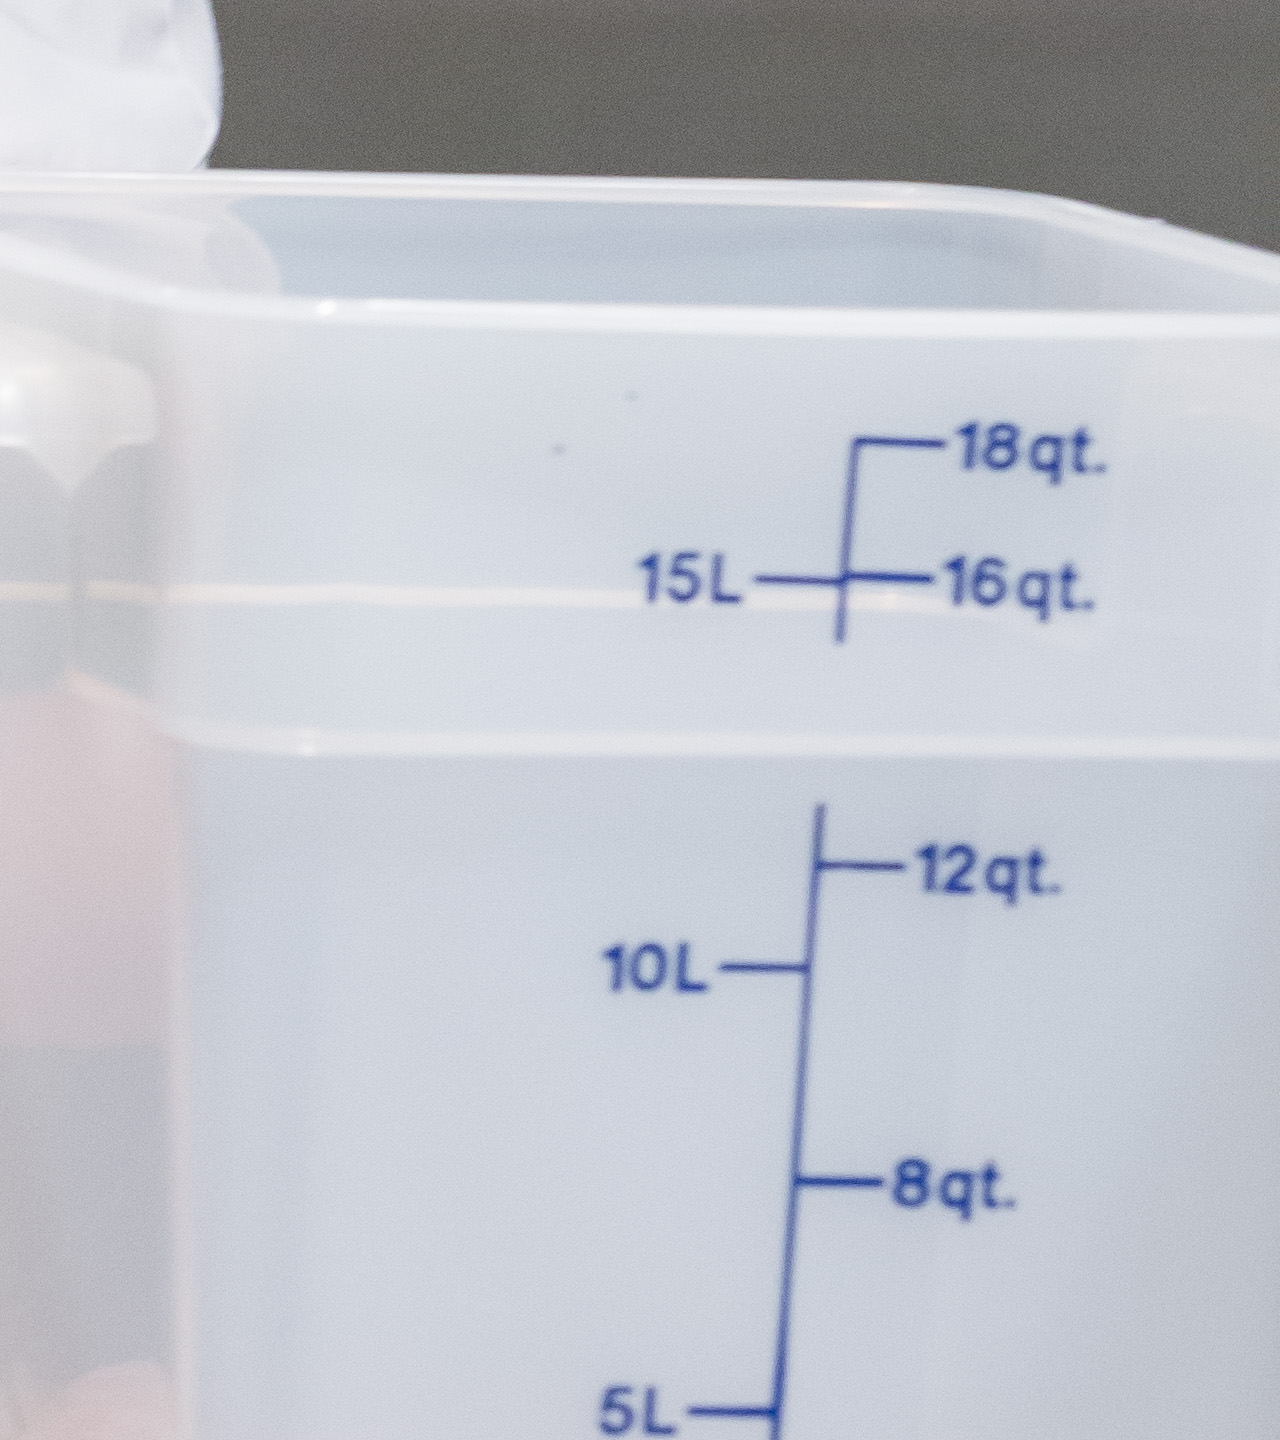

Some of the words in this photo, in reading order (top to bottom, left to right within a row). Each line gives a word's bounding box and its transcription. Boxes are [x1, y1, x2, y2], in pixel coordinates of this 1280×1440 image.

[955, 419, 1108, 486] 18qt.
[637, 549, 743, 606] 15L
[943, 553, 1096, 623] 16qt.
[914, 841, 1062, 907] 12qt.
[602, 940, 710, 995] 10L
[890, 1155, 1017, 1223] 8qt.
[598, 1384, 678, 1438] 5L
